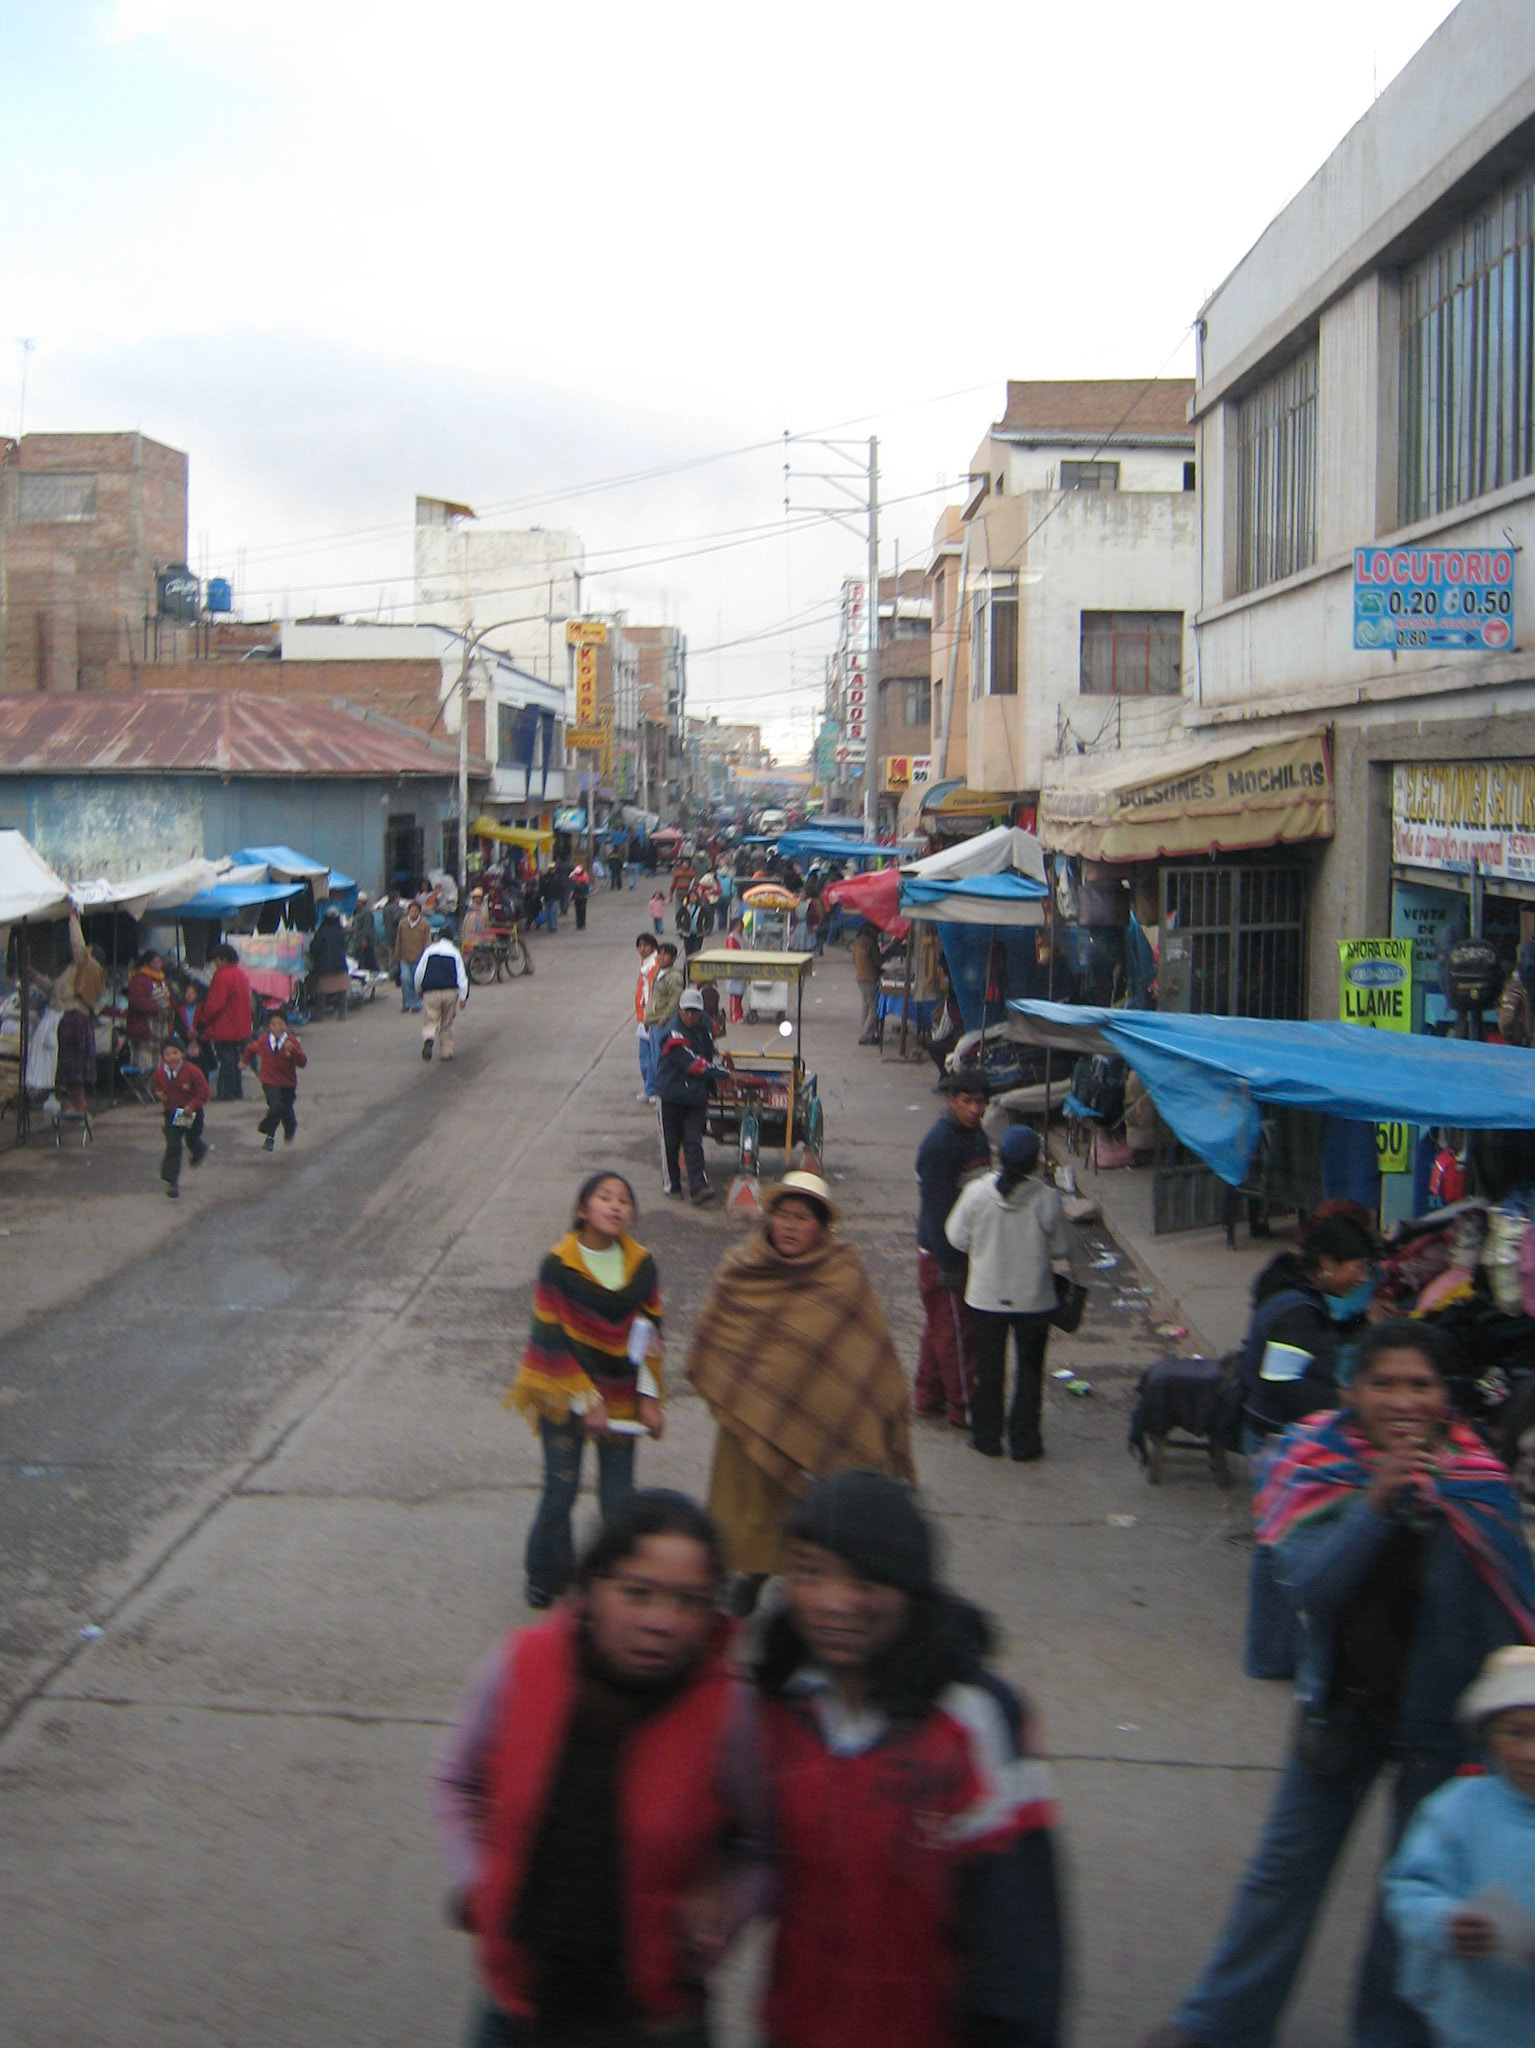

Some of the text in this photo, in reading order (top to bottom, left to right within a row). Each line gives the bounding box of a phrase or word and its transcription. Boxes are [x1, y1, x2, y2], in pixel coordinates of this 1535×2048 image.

[1356, 551, 1512, 585] LOCUTORIO
[1388, 590, 1511, 616] 0.20 0.50
[850, 584, 866, 738] REVELADOS
[580, 647, 592, 725] Kodak
[1227, 761, 1325, 797] MOCHILAS
[1403, 907, 1446, 921] VENTA
[1418, 924, 1436, 936] DE
[1346, 941, 1381, 959] AHORA
[1384, 941, 1407, 958] CON
[1345, 989, 1403, 1017] LLAME
